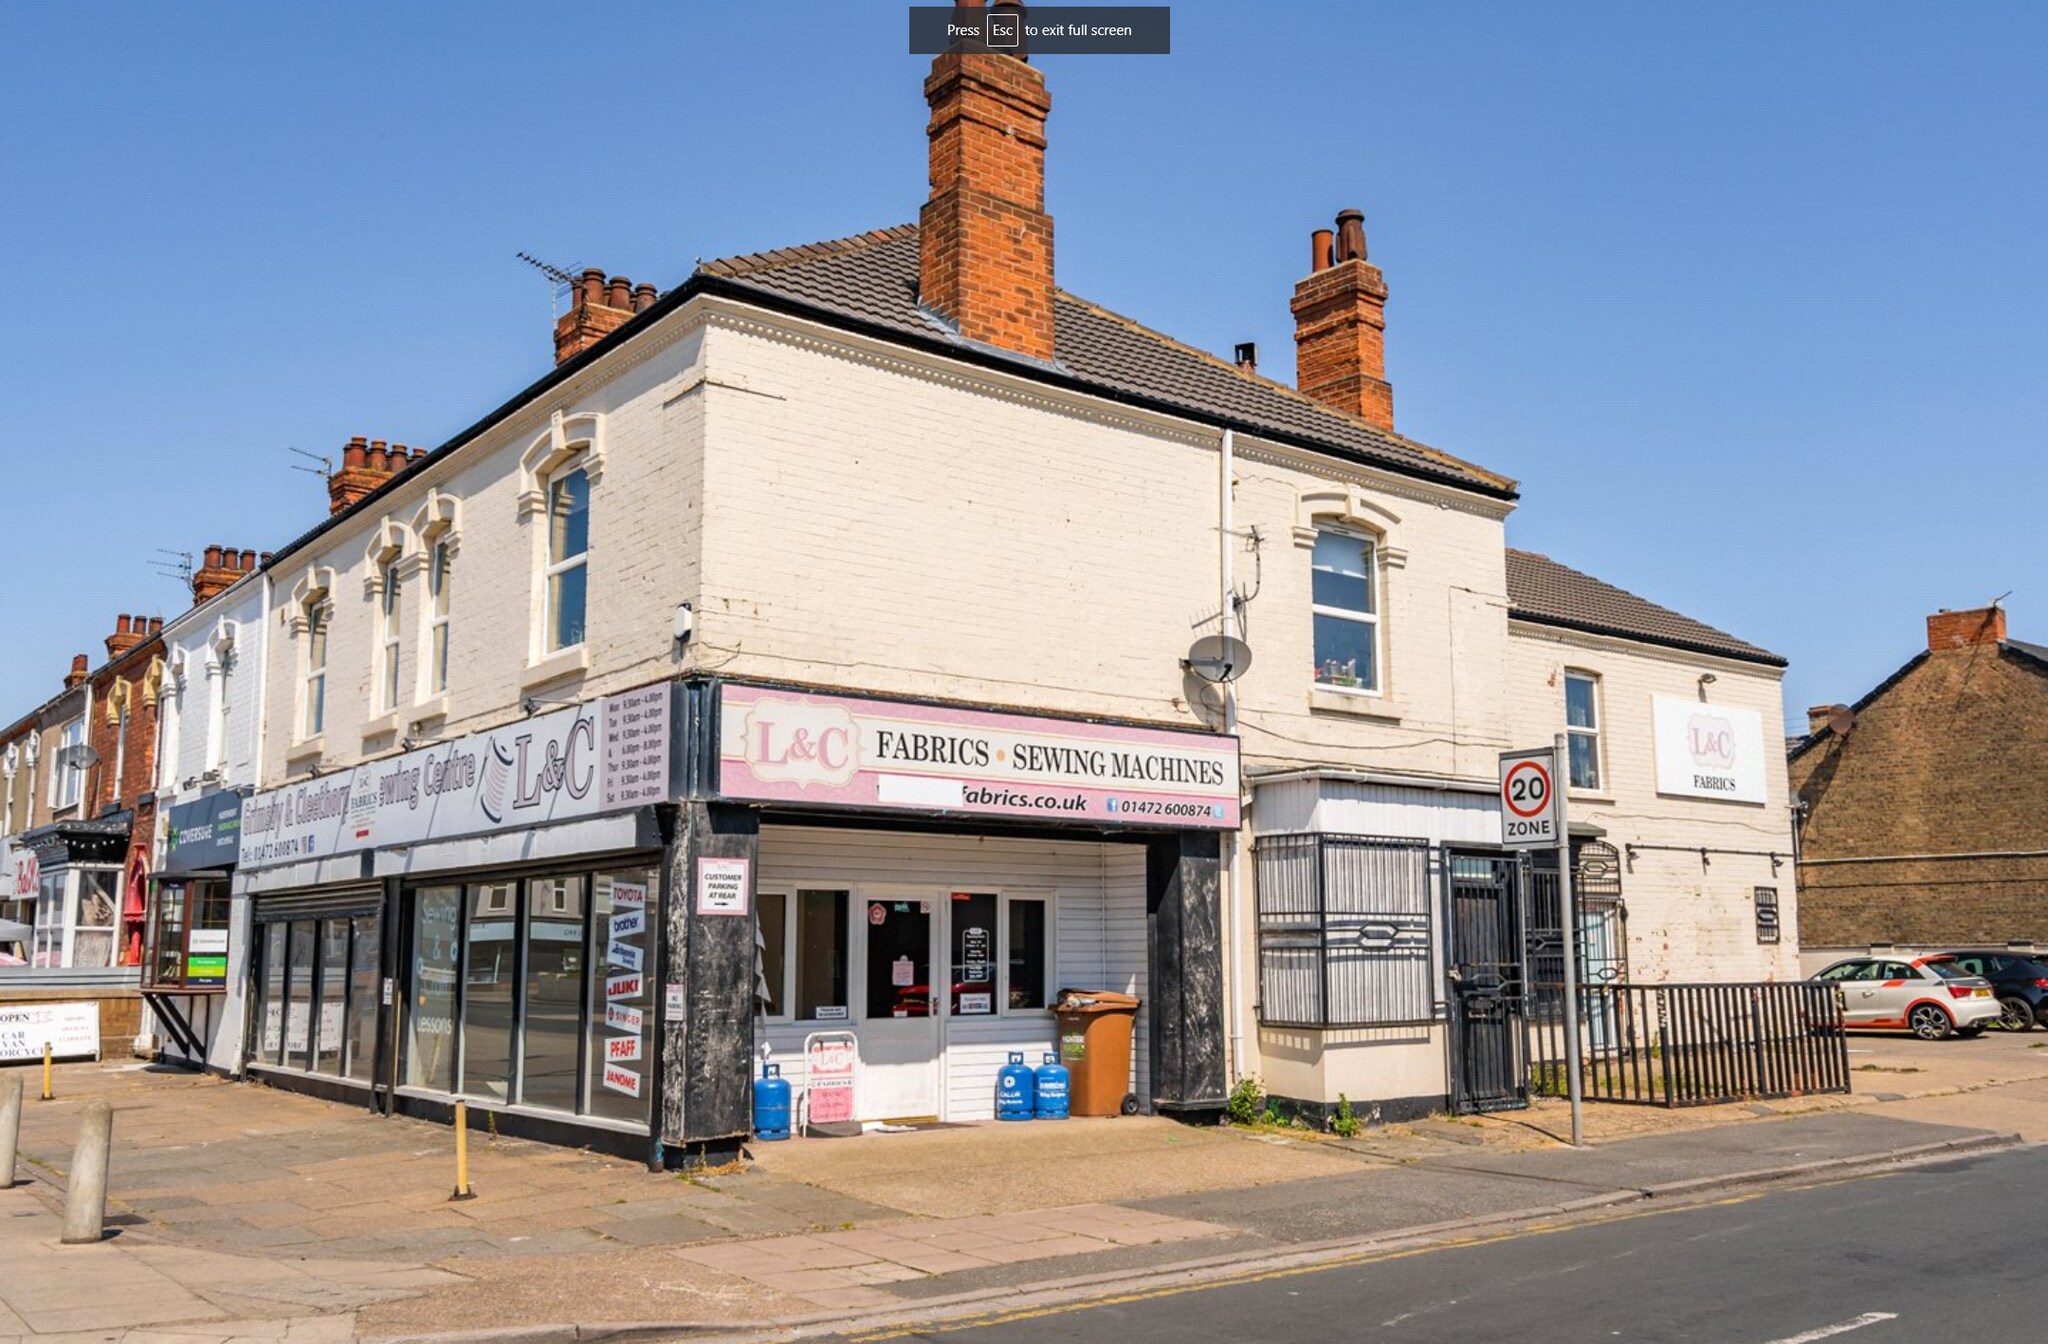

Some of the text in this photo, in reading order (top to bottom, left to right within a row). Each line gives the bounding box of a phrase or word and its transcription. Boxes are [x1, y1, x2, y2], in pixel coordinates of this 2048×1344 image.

[1692, 727, 1730, 758] L&C
[755, 720, 1224, 786] L&C FABRICS SEWING MACHINES
[513, 716, 594, 809] L&C
[1512, 776, 1545, 801] 20
[1693, 774, 1736, 791] FABRICS
[243, 750, 476, 839] Grimsby & Cleethorp ewing Centre
[1122, 800, 1162, 815] 01472
[1165, 803, 1211, 818] 600874
[1507, 820, 1550, 836] ZONE
[254, 843, 273, 861] 01472
[274, 840, 298, 858] 600874
[704, 873, 742, 881] CUSTOMER
[613, 886, 642, 902] TOYOTA
[422, 905, 457, 931] Sewing
[613, 915, 639, 933] brother
[608, 979, 639, 996] JUKI
[0, 1013, 30, 1022] OPEN
[417, 1016, 452, 1034] Lessons
[615, 1010, 641, 1025] SINGER
[2, 1031, 25, 1039] CAR
[2, 1040, 25, 1048] VAN
[0, 1047, 44, 1057] ORCYCL
[610, 1039, 636, 1058] PFAFF
[606, 1069, 636, 1091] JANOME
